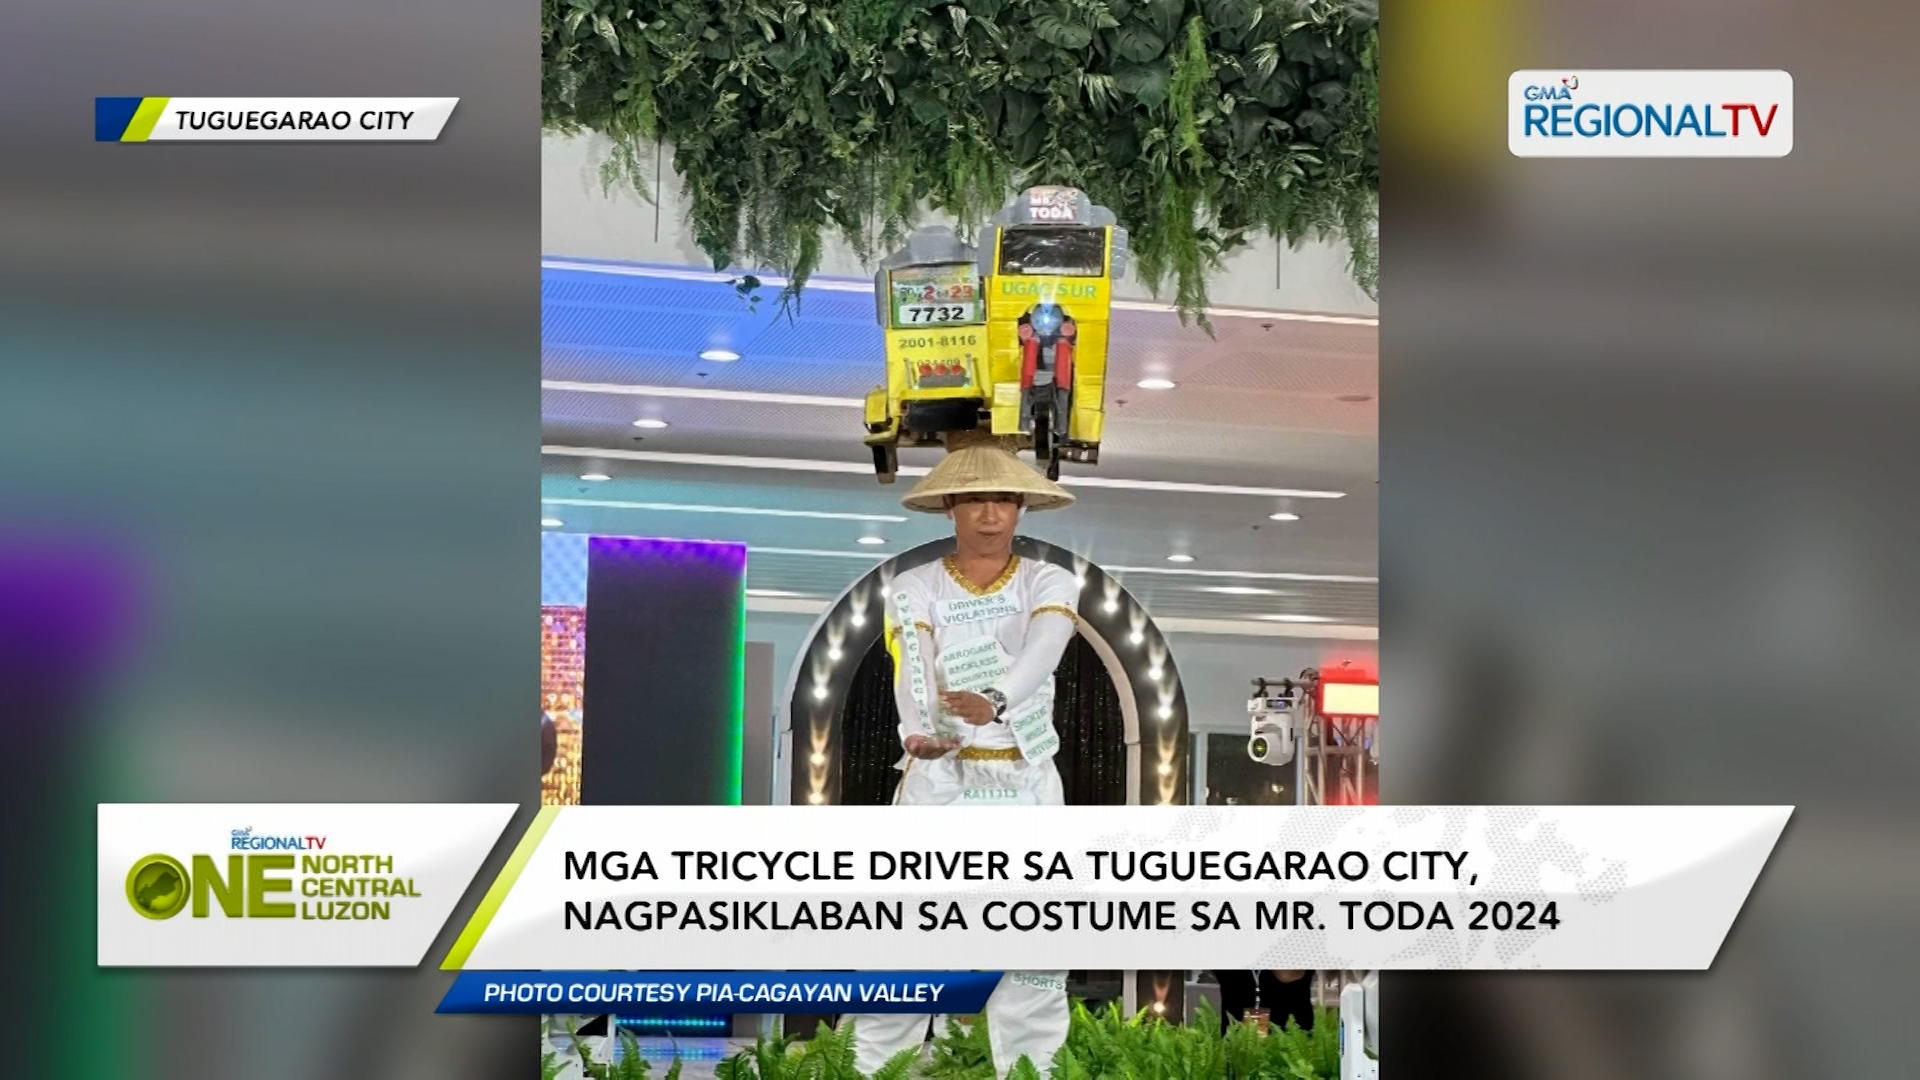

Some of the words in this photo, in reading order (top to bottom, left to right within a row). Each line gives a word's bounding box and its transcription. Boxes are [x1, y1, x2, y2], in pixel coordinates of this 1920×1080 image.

[1029, 207, 1075, 220] TODA
[1057, 283, 1097, 298] SUR
[909, 307, 965, 322] 7732
[899, 335, 977, 348] 2001-8116
[943, 605, 1018, 624] VIOLATIONS
[942, 641, 998, 663] ARROGANT
[1012, 971, 1063, 989] SHORTS
